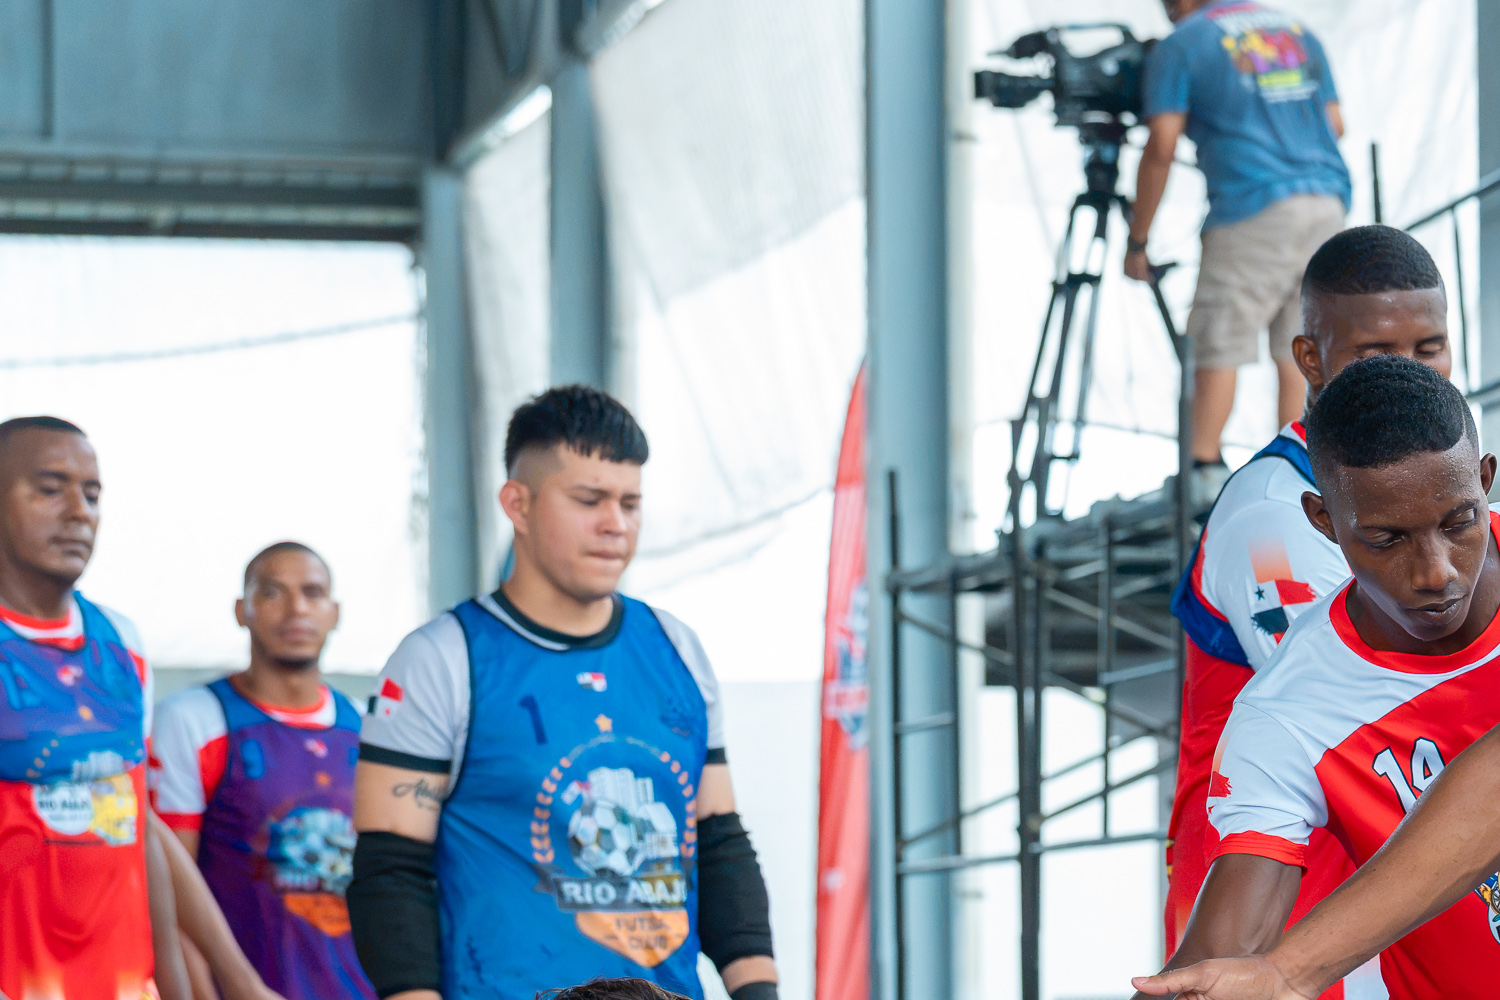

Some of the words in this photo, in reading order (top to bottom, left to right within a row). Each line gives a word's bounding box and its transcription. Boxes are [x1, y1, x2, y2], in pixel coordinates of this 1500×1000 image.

[518, 694, 548, 745] 1
[1371, 735, 1446, 815] 14
[562, 881, 617, 905] RIO
